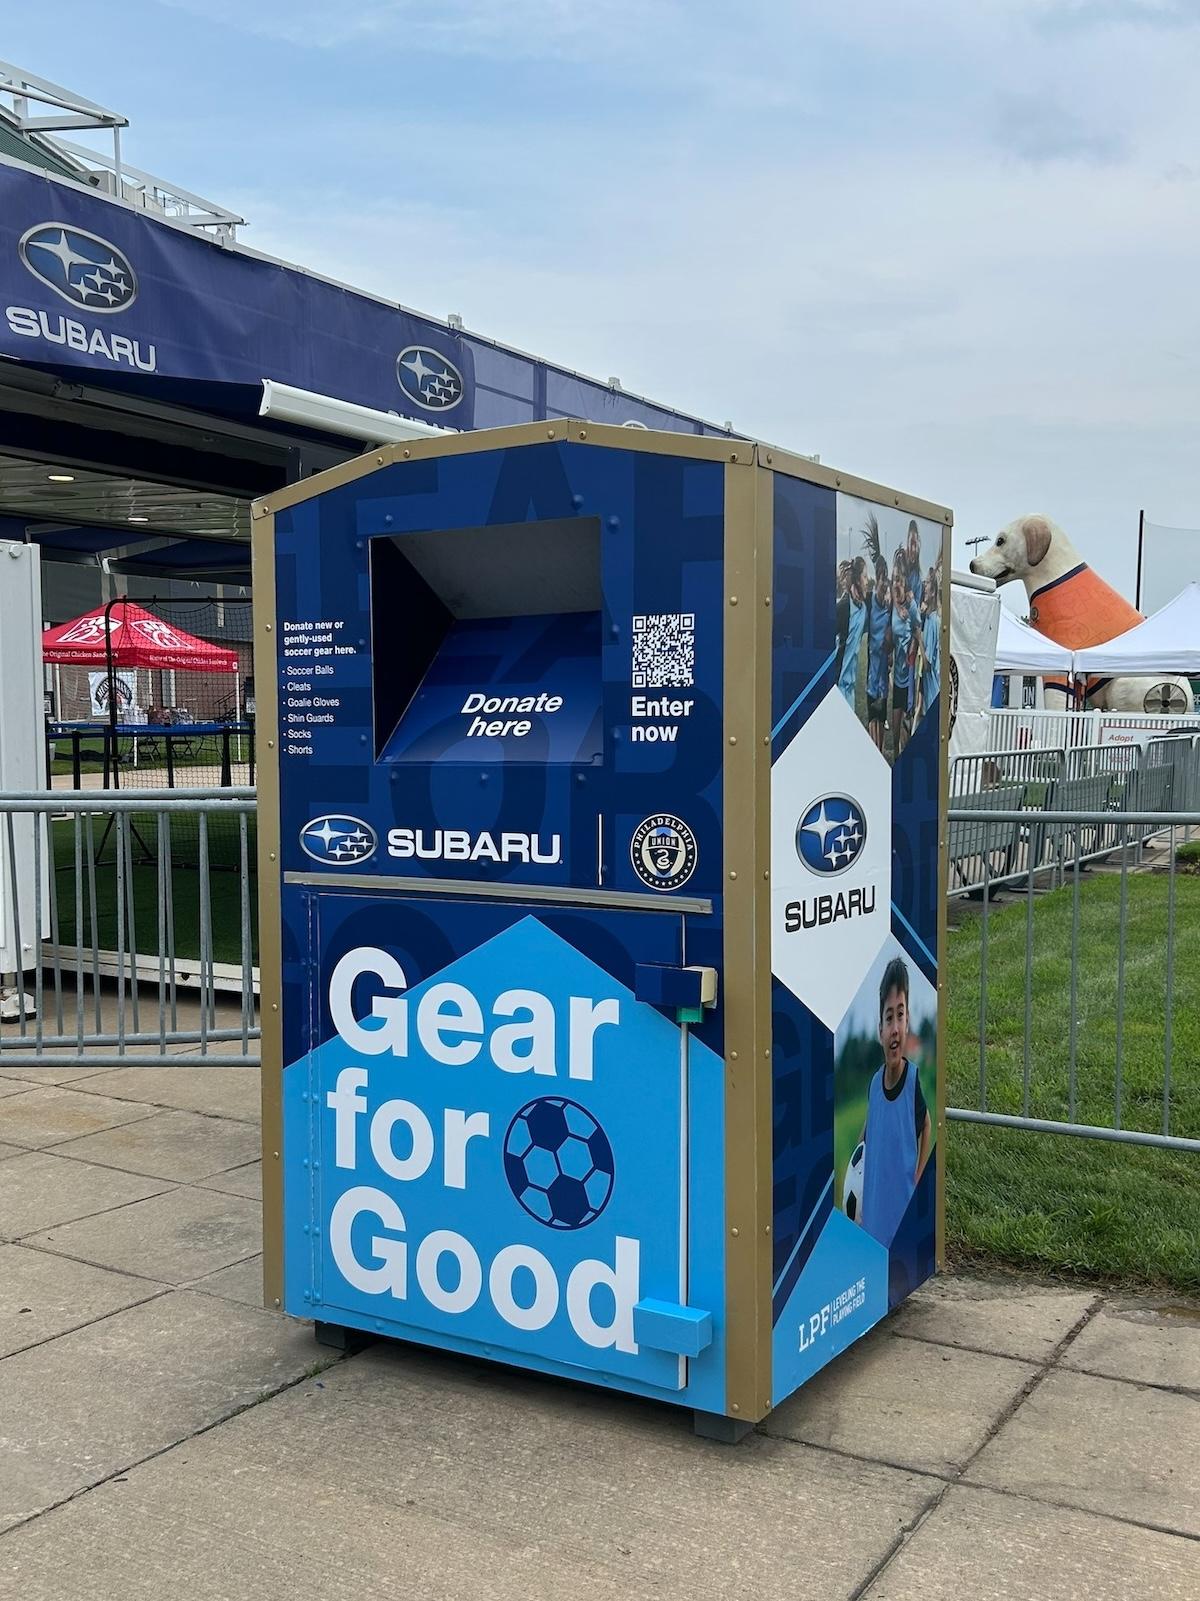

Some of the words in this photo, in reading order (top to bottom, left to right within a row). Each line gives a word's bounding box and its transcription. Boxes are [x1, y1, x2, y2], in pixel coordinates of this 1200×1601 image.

[6, 306, 157, 372] SUBARU
[284, 621, 313, 631] Donate
[315, 622, 332, 630] new
[334, 621, 344, 629] or
[284, 633, 332, 645] gently-used
[284, 647, 312, 656] soccer
[314, 647, 333, 657] gear
[335, 646, 356, 655] here.
[287, 666, 313, 676] Soccer
[315, 665, 334, 675] Balls
[287, 682, 311, 692] Cleats
[287, 697, 312, 707] Goalie
[313, 697, 340, 707] Gloves
[461, 692, 564, 714] Donate
[631, 696, 694, 717] Enter
[288, 713, 305, 723] Shin
[306, 713, 334, 723] Guards
[467, 716, 532, 737] here
[288, 729, 312, 739] Socks
[631, 725, 678, 742] now
[1108, 734, 1134, 743] Adopt
[288, 744, 313, 754] Shorts
[633, 817, 694, 851] PHILADELPHIA
[651, 837, 676, 846] UNION
[387, 828, 561, 864] SUBARU
[785, 885, 876, 933] SUBARU
[329, 946, 620, 1081] Gear
[327, 1066, 490, 1190] for
[329, 1186, 640, 1355] Good
[833, 1284, 857, 1312] LEVELING
[856, 1277, 866, 1295] THE
[833, 1302, 853, 1326] PLAYING
[853, 1292, 866, 1311] FIELD
[798, 1303, 831, 1353] LPF
